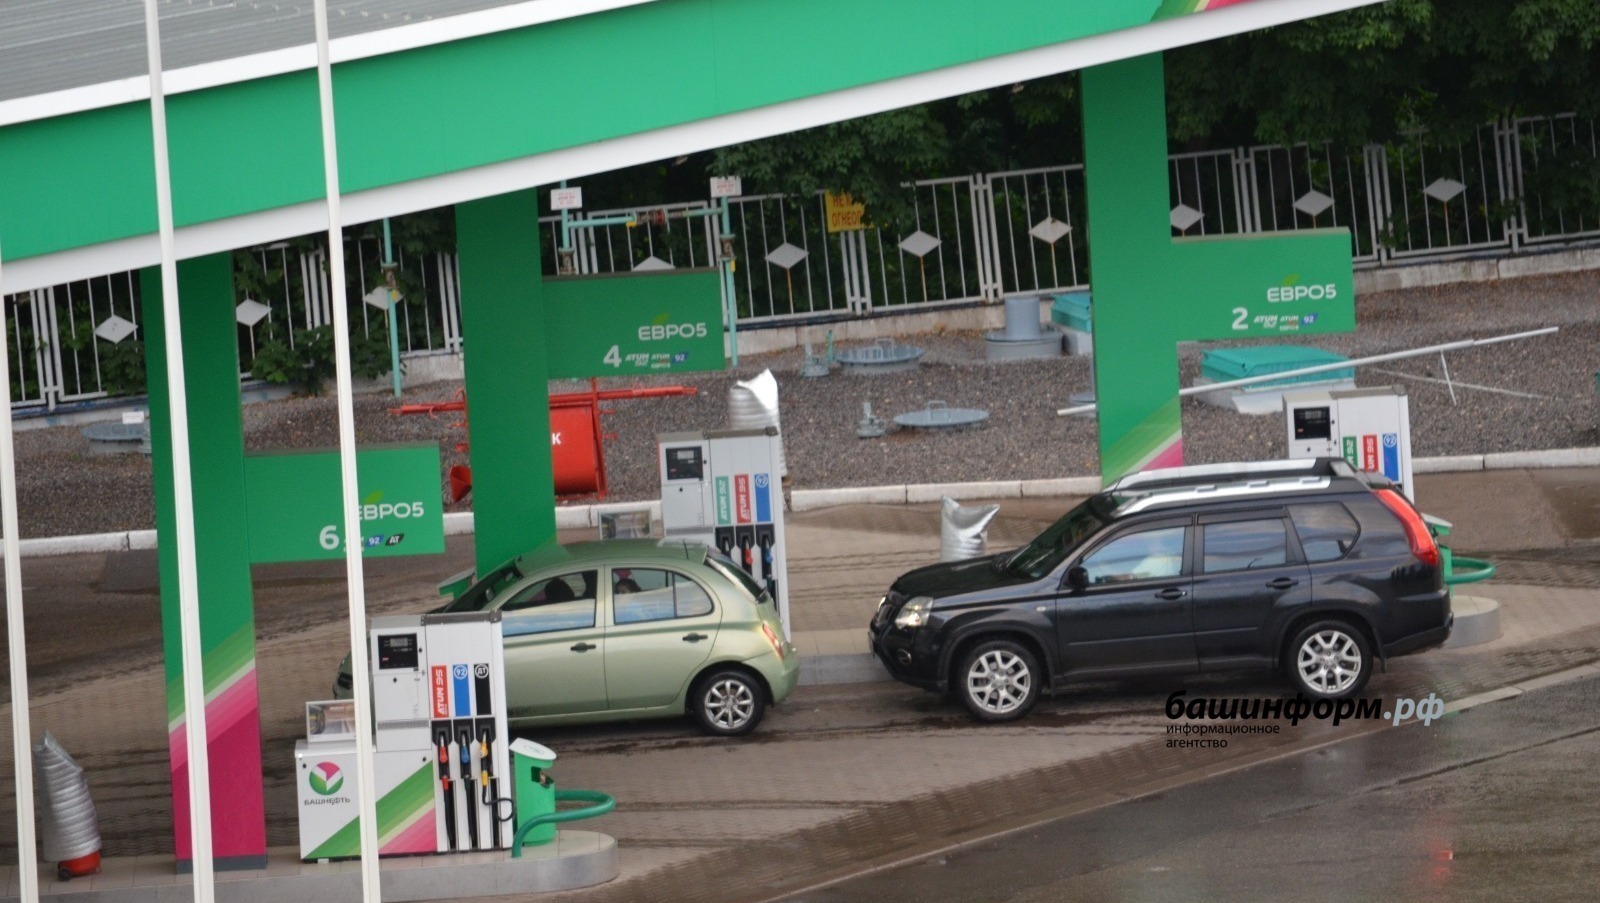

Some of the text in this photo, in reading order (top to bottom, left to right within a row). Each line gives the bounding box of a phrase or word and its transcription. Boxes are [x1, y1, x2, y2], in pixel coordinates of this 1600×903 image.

[1266, 283, 1337, 302] ЕВРО5
[1231, 307, 1249, 330] 2
[637, 322, 708, 341] ЕВРО5
[602, 344, 622, 368] 4
[319, 525, 340, 550] 6
[368, 536, 380, 545] 92
[457, 668, 466, 676] 92
[437, 687, 446, 715] ATUM
